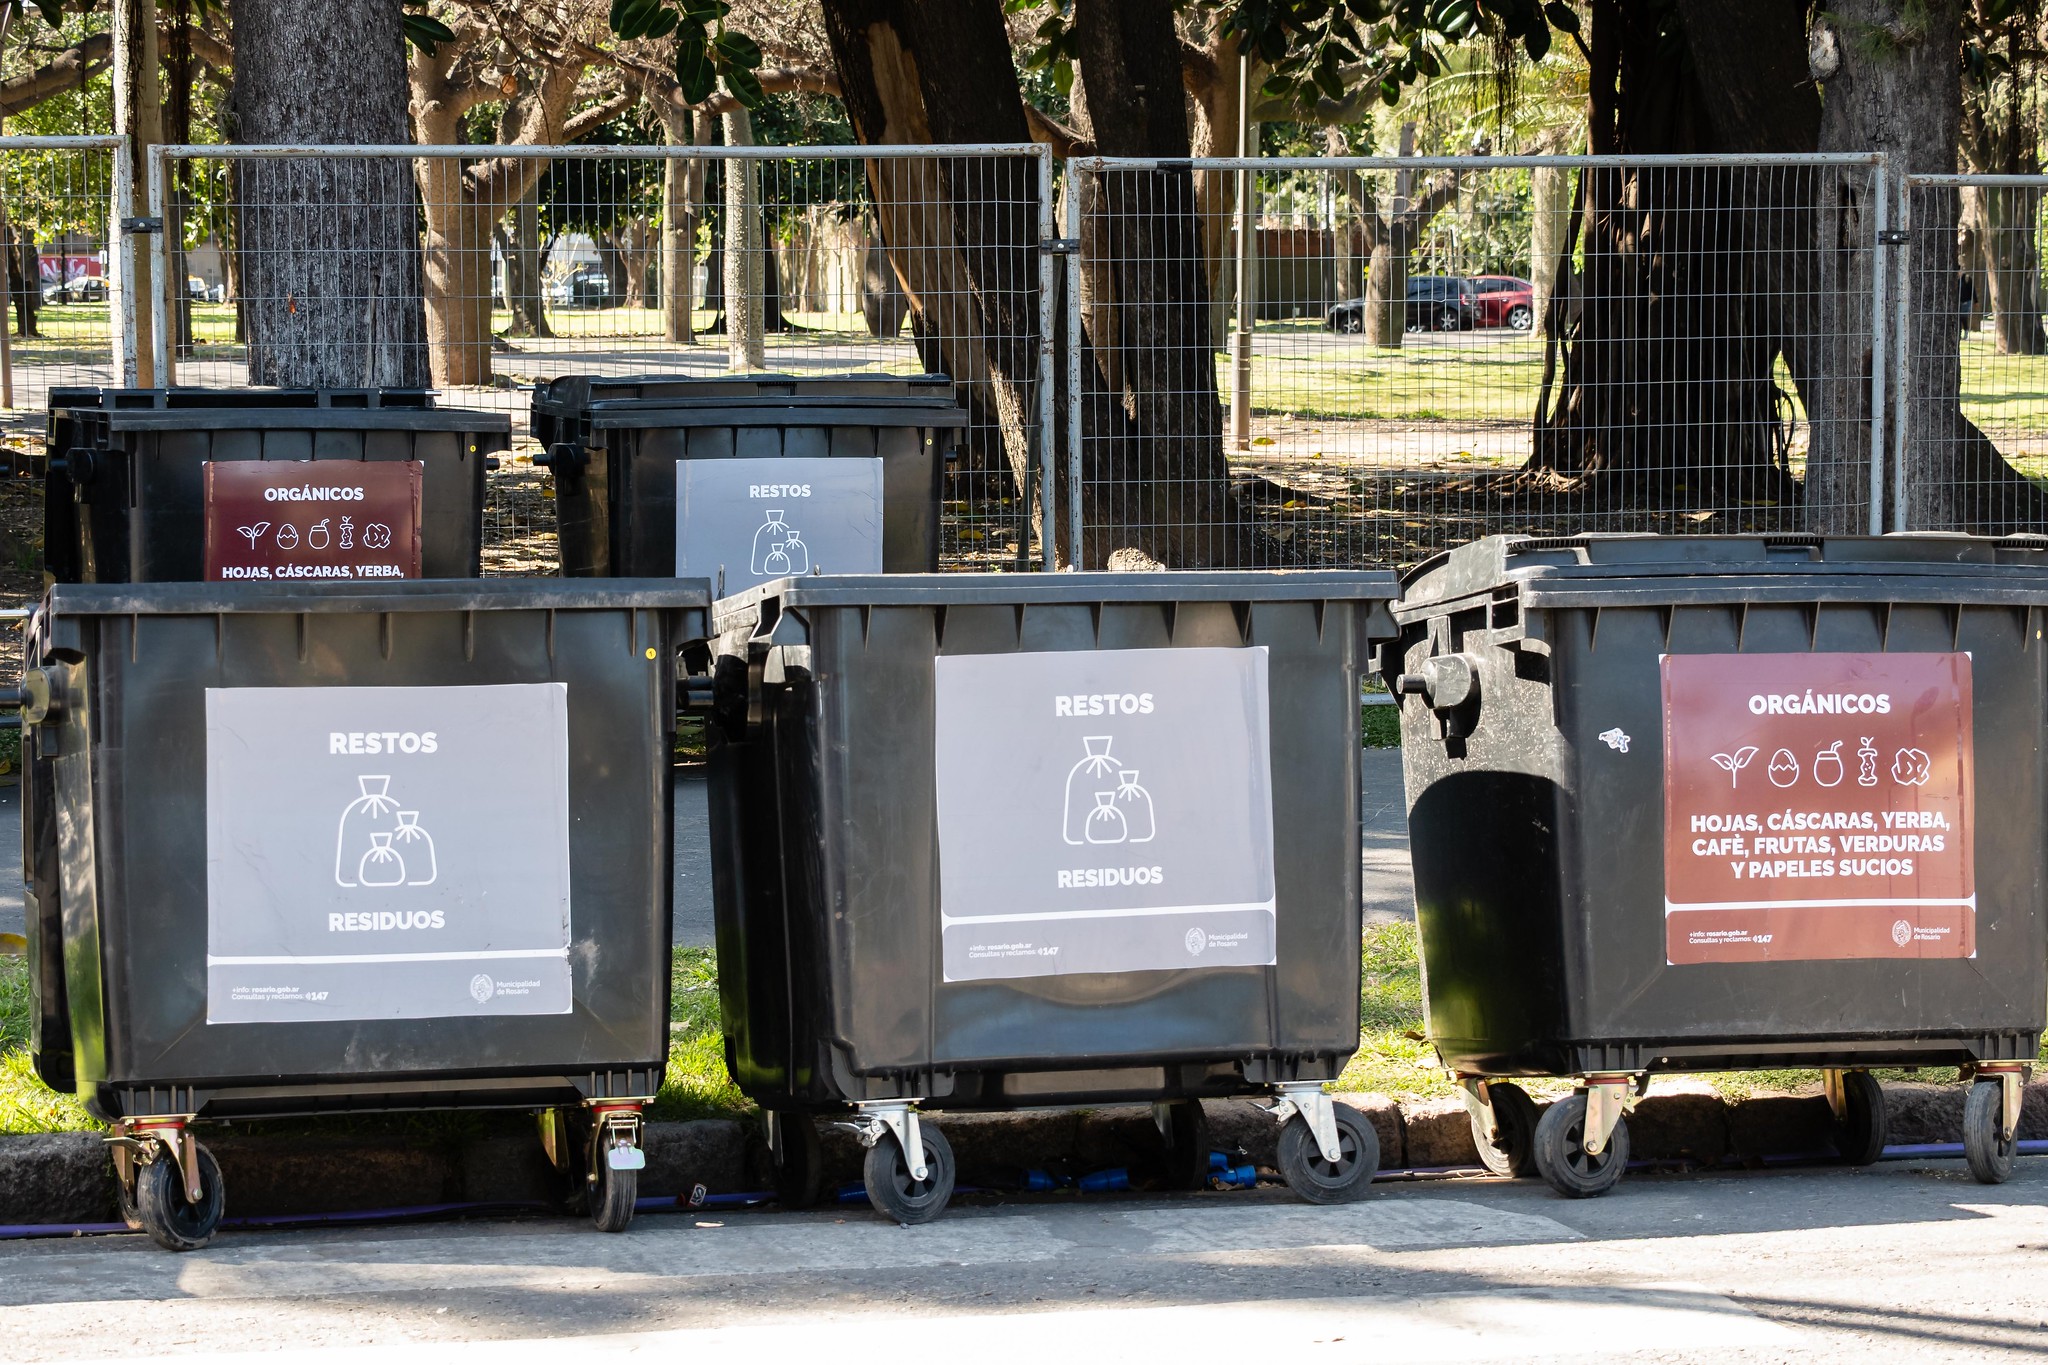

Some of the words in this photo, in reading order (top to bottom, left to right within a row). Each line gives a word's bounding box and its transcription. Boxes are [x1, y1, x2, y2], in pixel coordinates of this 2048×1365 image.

[264, 484, 364, 501] ORGÁNICOS
[749, 484, 811, 498] RESTOS
[222, 566, 272, 580] HOJAS,
[275, 563, 354, 579] CÁSCARAS,
[355, 564, 404, 578] YERBA,
[1055, 692, 1154, 717] RESTOS
[1748, 688, 1891, 715] ORGÁNICOS
[329, 731, 438, 754] RESTOS
[1691, 814, 1763, 834] HOJAS,
[1767, 809, 1878, 832] CÁSCARAS,
[1881, 811, 1951, 831] YERBA,
[1754, 836, 1836, 856] FRUTAS,
[1839, 834, 1945, 853] VERDURAS
[1057, 865, 1163, 889] RESIDUOS
[1730, 861, 1746, 879] Y
[1749, 859, 1835, 878] PAPELES
[1839, 858, 1914, 877] SUCIOS
[328, 909, 446, 931] RESIDUOS
[1208, 932, 1248, 941] Municipalidad
[1706, 929, 1748, 938] rosario.gob.ar
[1913, 927, 1951, 935] Municipalidad
[968, 950, 1001, 958] Consultas
[987, 942, 1032, 951] rosario.gob.ar
[251, 985, 299, 994] rosario.gob.ar
[496, 980, 541, 988] Municipalidad
[506, 987, 530, 995] Rosario
